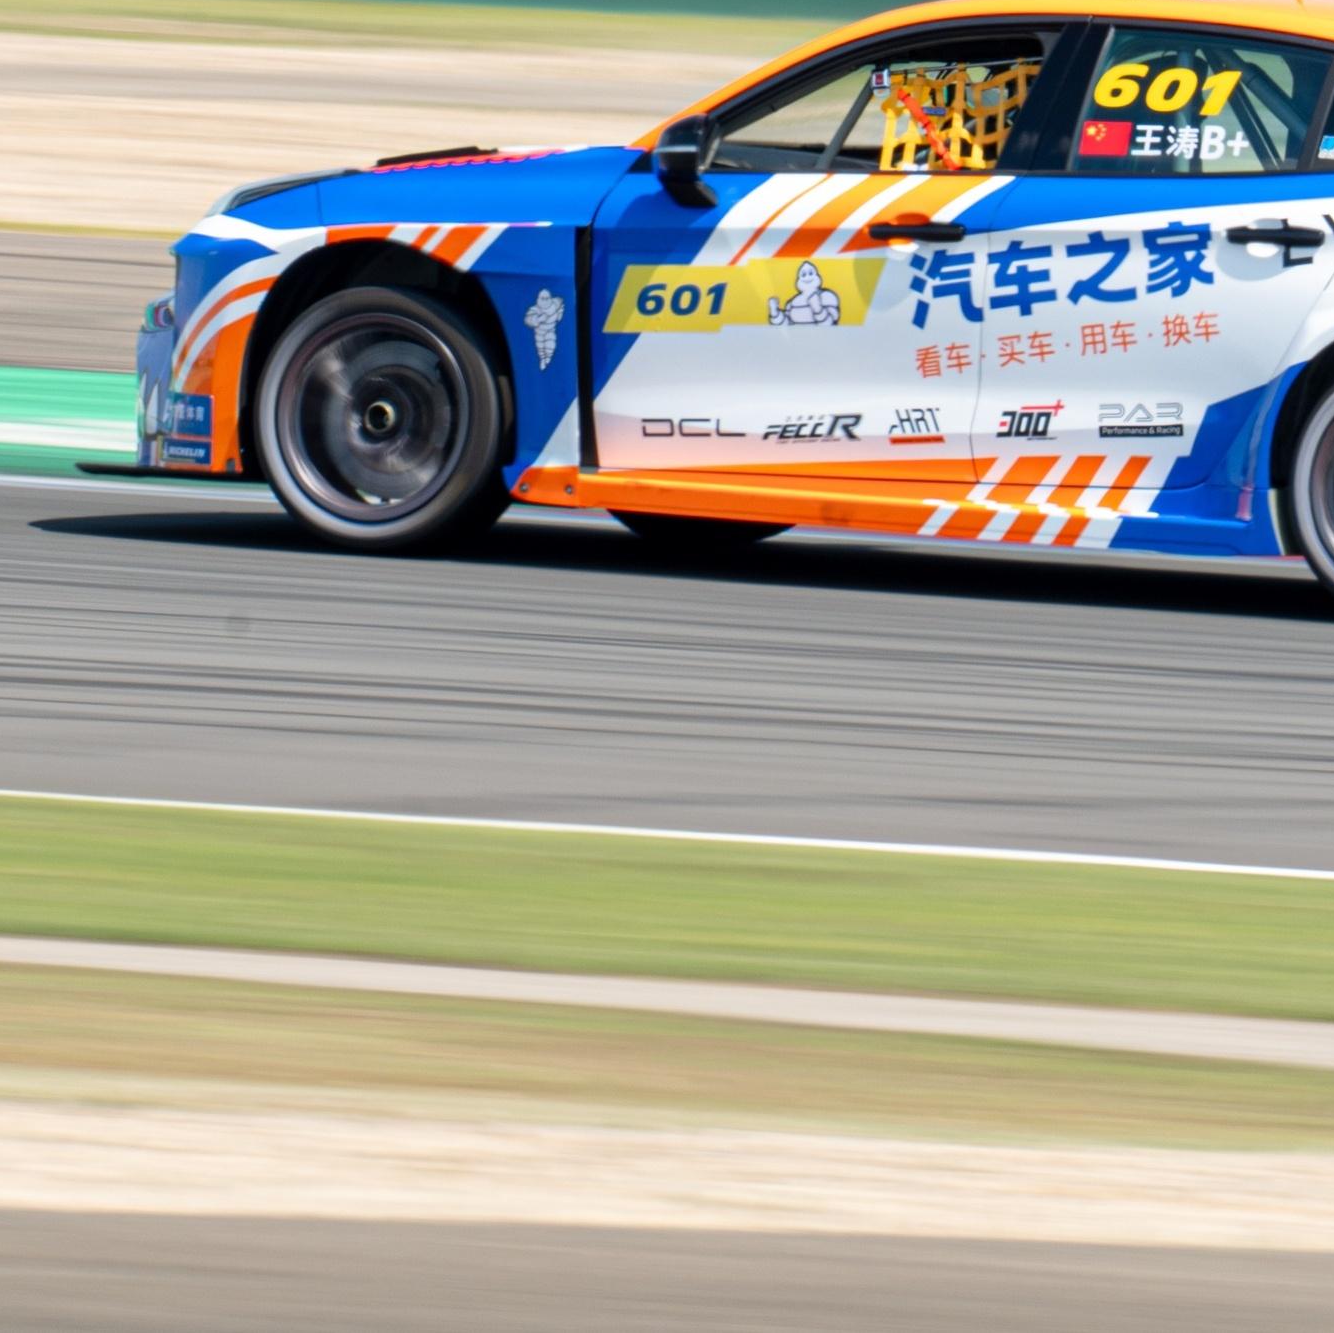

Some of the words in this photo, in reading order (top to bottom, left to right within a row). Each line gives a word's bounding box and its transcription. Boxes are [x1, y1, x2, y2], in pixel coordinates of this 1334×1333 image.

[1093, 62, 1242, 116] 601
[909, 221, 1215, 330] 汽车之家
[636, 282, 727, 316] 601
[1098, 402, 1183, 423] PAR
[641, 418, 746, 437] DCL
[1101, 427, 1148, 435] Performance
[1156, 426, 1181, 435] Racing
